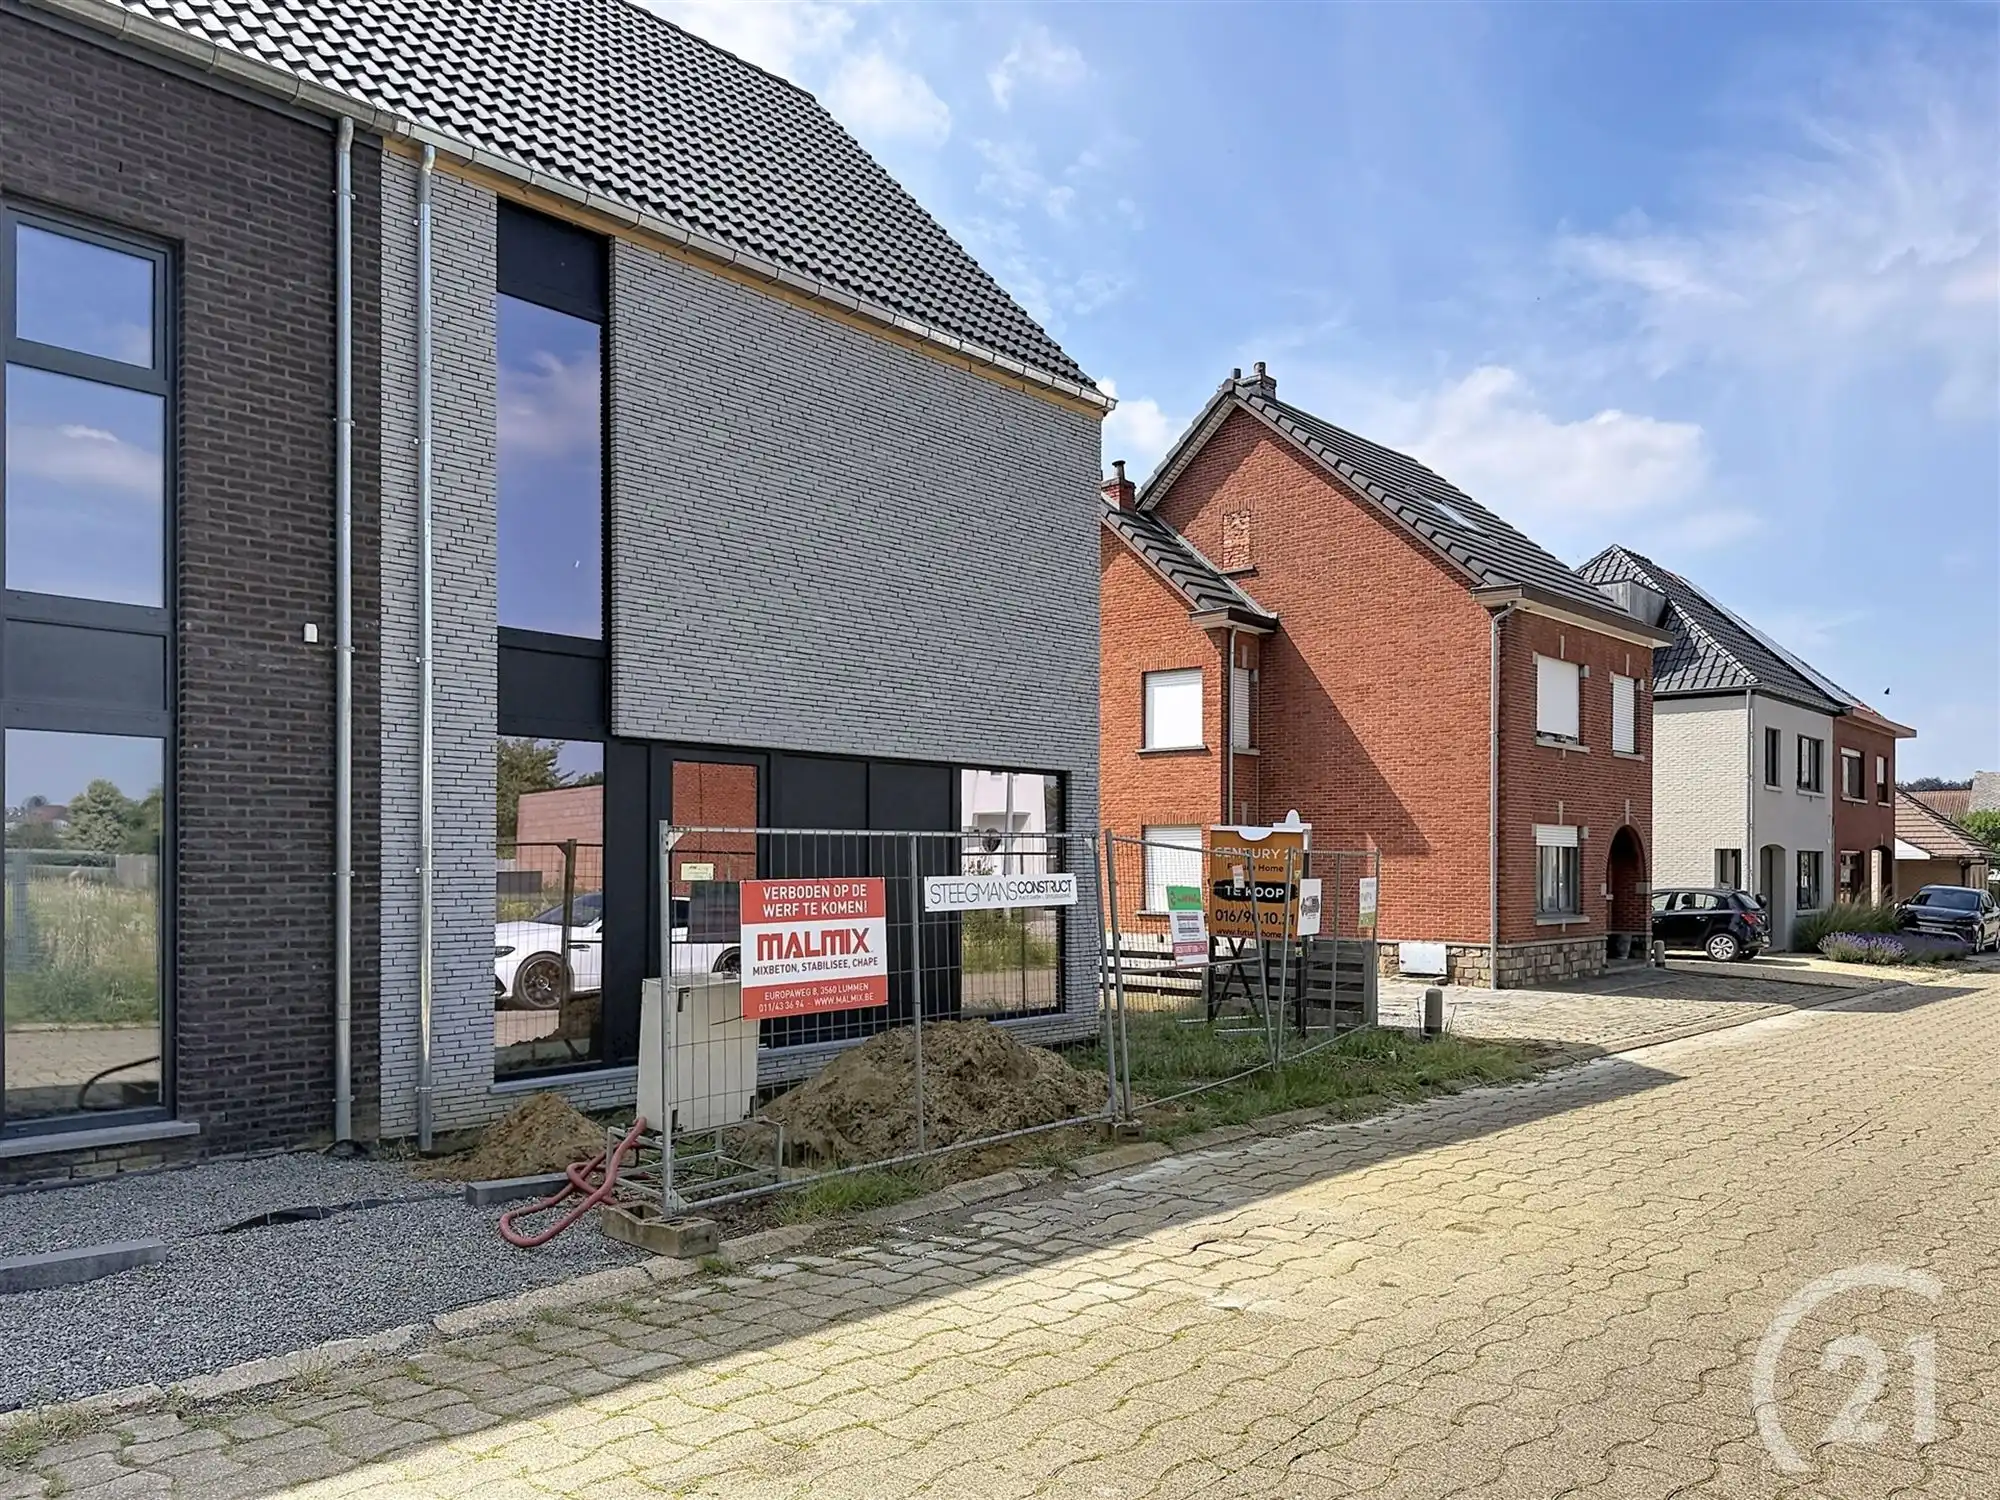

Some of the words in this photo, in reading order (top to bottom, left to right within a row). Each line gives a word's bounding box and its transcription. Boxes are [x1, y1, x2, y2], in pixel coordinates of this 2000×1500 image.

[1258, 864, 1284, 872] Home
[763, 885, 830, 900] VERBODEN
[833, 884, 849, 898] OP
[852, 884, 867, 897] DE
[1225, 885, 1241, 896] TE
[1246, 887, 1285, 898] KOOP
[763, 902, 800, 918] WERF
[803, 902, 818, 916] TE
[821, 900, 868, 915] KOMEN!
[757, 927, 870, 961] MALMIX
[752, 963, 800, 976] MIXBETON,
[801, 959, 851, 972] STABILISEE,
[852, 957, 878, 968] CHAPE
[764, 987, 812, 1001] EUROPAWEG
[820, 985, 837, 996] 3560
[838, 982, 869, 994] LUMMEN
[814, 992, 875, 1007] WWW.MALMIX.BE
